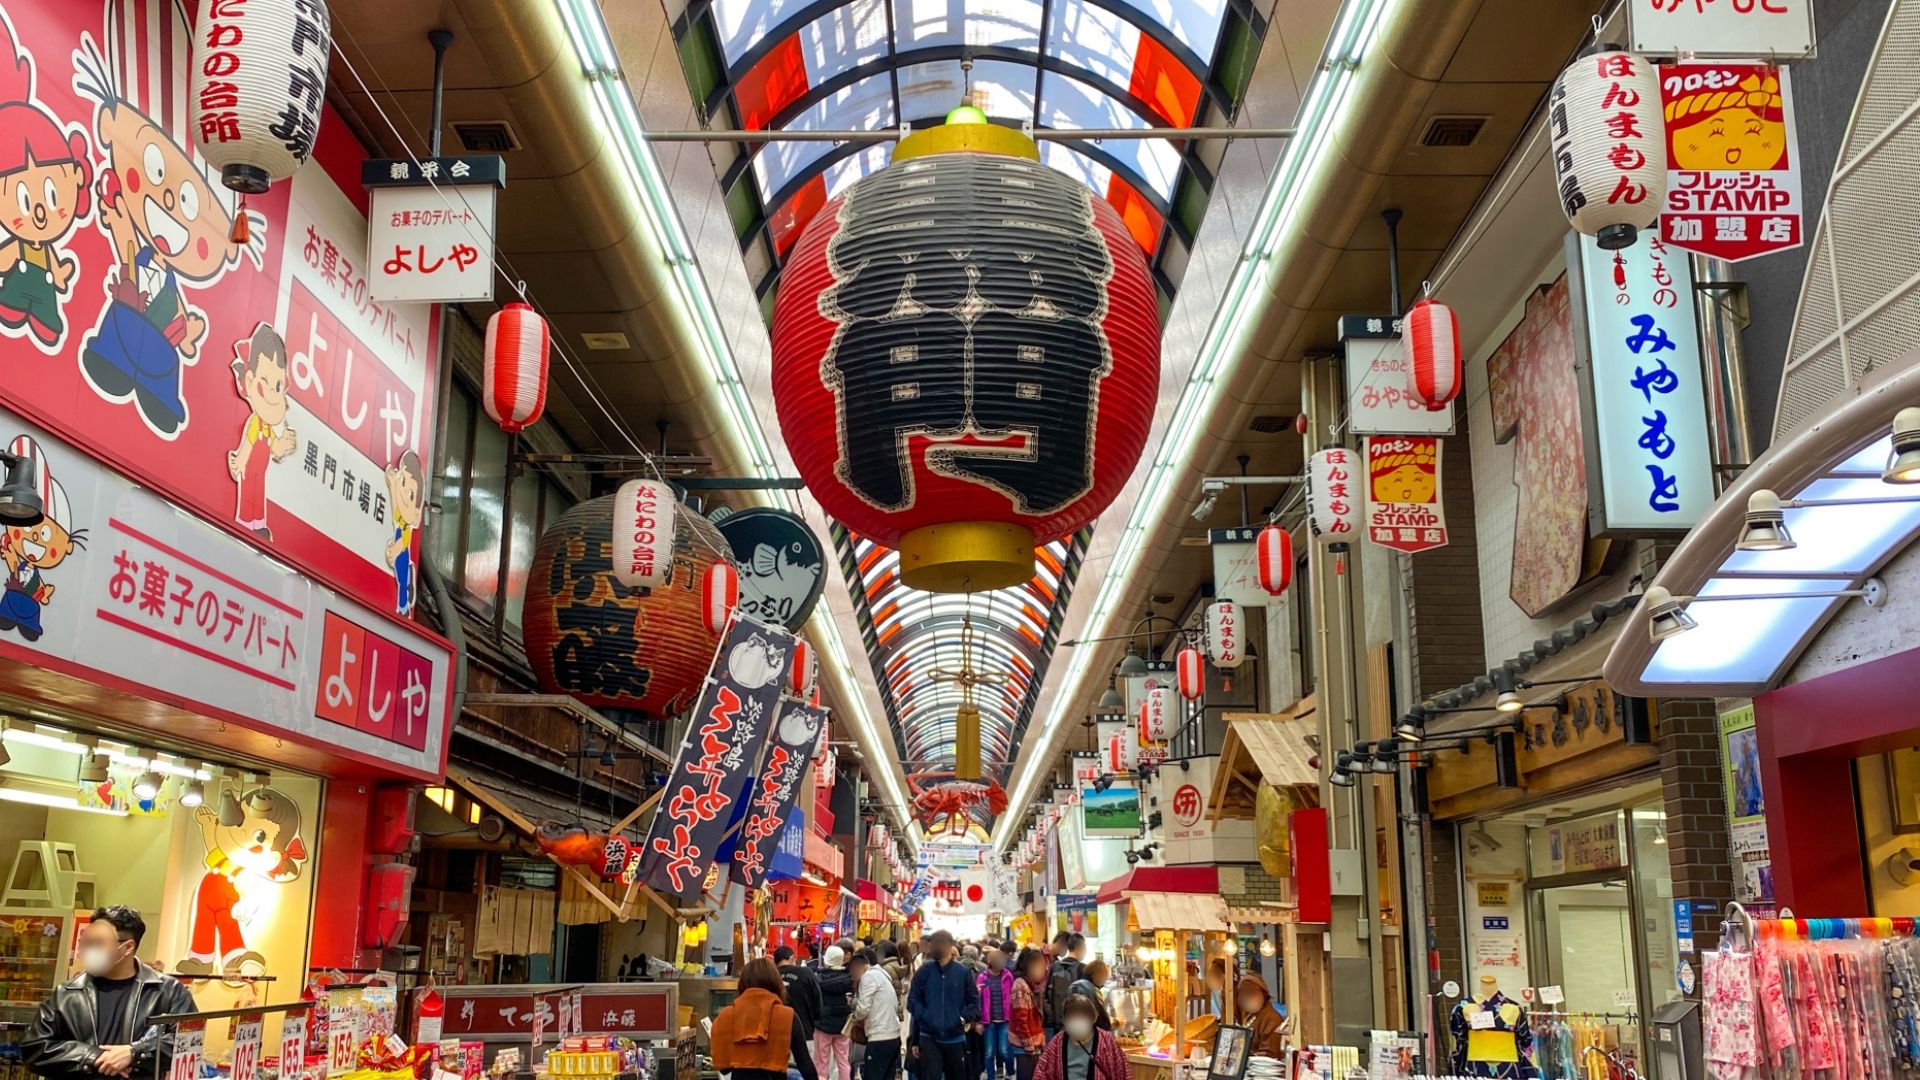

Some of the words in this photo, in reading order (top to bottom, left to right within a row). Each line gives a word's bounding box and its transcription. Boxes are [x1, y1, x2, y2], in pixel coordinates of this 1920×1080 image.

[1664, 70, 1741, 97] クロモン
[1597, 55, 1647, 205] ほんまもん
[1678, 171, 1776, 190] フレッシュ
[391, 208, 473, 227] お菓子のデパート
[1669, 190, 1790, 211] STAMP
[1670, 217, 1792, 242] 加盟店
[383, 243, 478, 275] よしや
[291, 312, 408, 463] よしや
[1625, 314, 1680, 512] みやもと
[1371, 440, 1414, 455] クロモン
[303, 439, 386, 525] 黒門市場店
[1326, 451, 1352, 534] ほんまもん
[1373, 513, 1438, 526] STAMP
[1377, 503, 1430, 514] フレッシュ
[630, 485, 657, 577] なにわの台所
[1374, 529, 1441, 543] 加盟店
[109, 549, 297, 670] お菓子のデパート
[1219, 604, 1236, 662] ほんまもん
[325, 632, 427, 736] よしや
[604, 837, 627, 875] 浜藤
[282, 1038, 300, 1077] 155
[333, 1031, 353, 1069] 159
